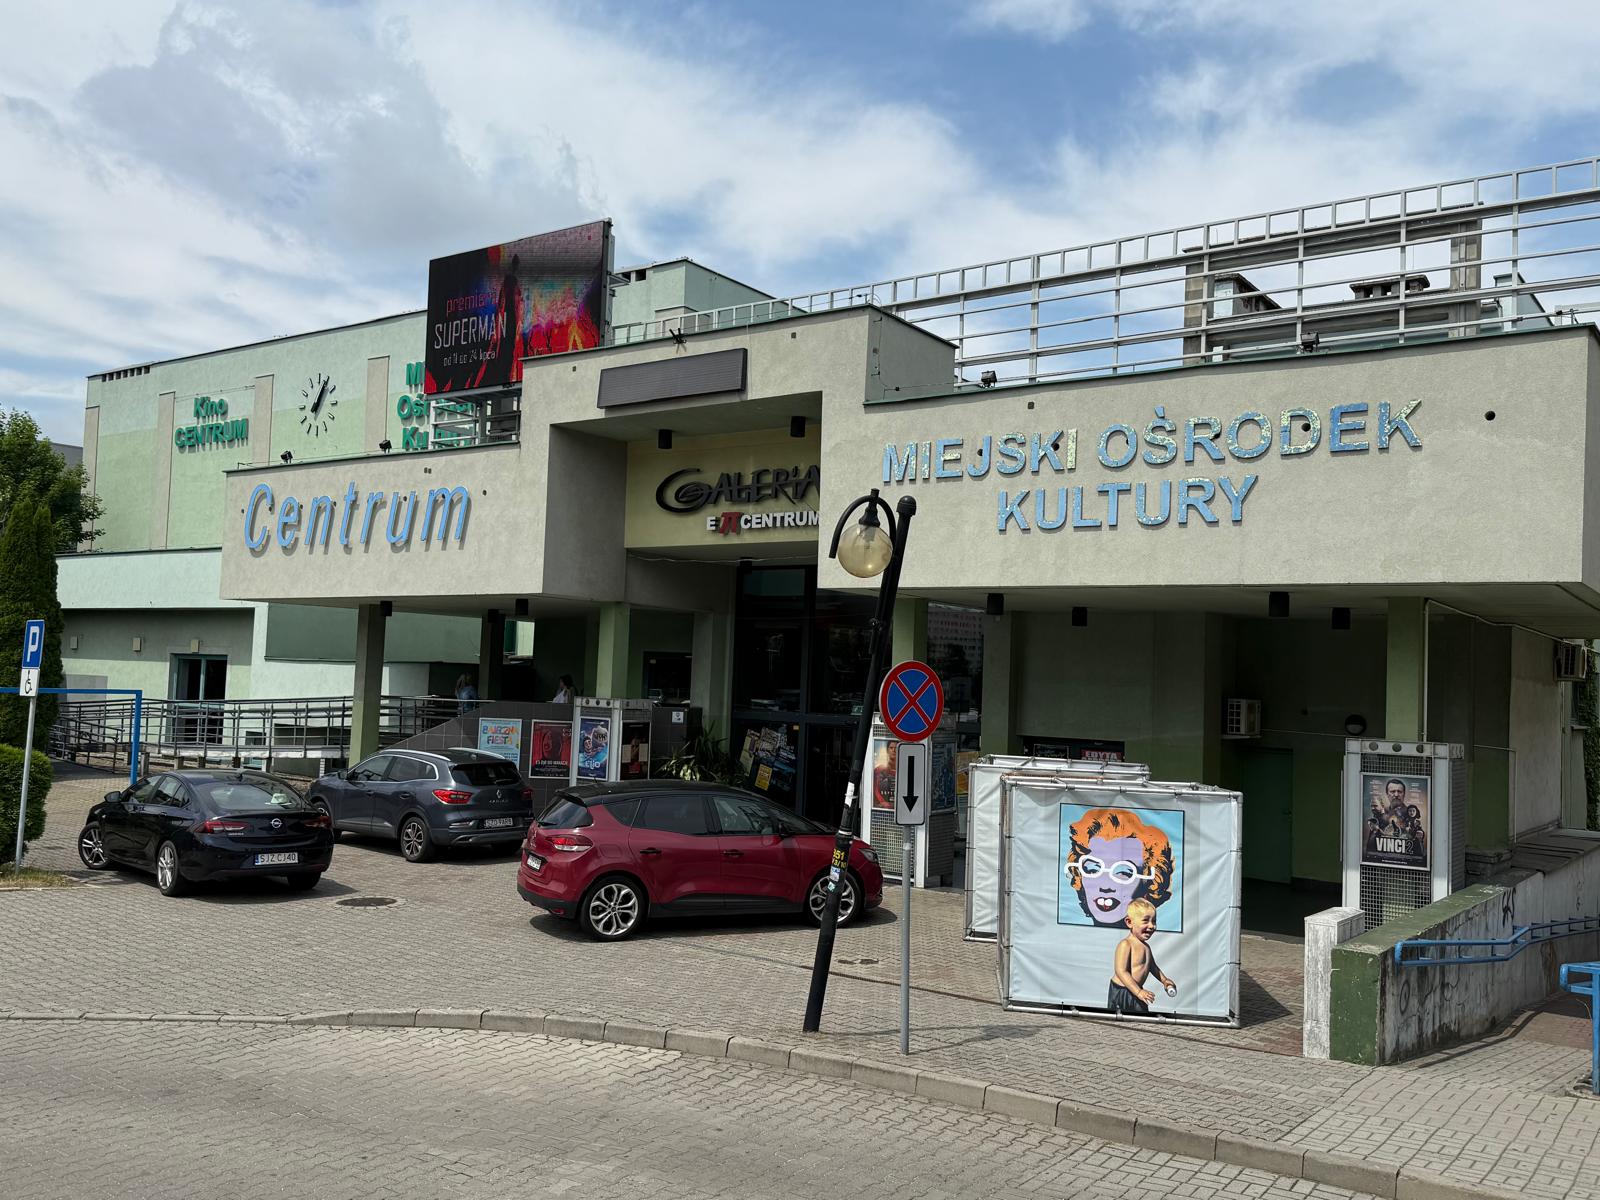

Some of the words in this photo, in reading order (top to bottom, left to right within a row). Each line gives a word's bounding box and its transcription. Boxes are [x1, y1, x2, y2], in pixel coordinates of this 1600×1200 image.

[434, 311, 507, 349] SUPERMAN
[193, 396, 227, 418] Kino
[175, 418, 248, 447] CENTRUM
[882, 428, 1078, 484] MIEJSKI
[1097, 399, 1423, 468] OŚRODEK
[244, 481, 469, 550] Centrum
[998, 474, 1258, 531] KULTURY
[27, 626, 40, 662] P
[486, 735, 513, 745] FIESTA
[1085, 750, 1118, 759] EDYTA
[260, 854, 275, 863] SJZ
[1376, 837, 1405, 854] VINCI
